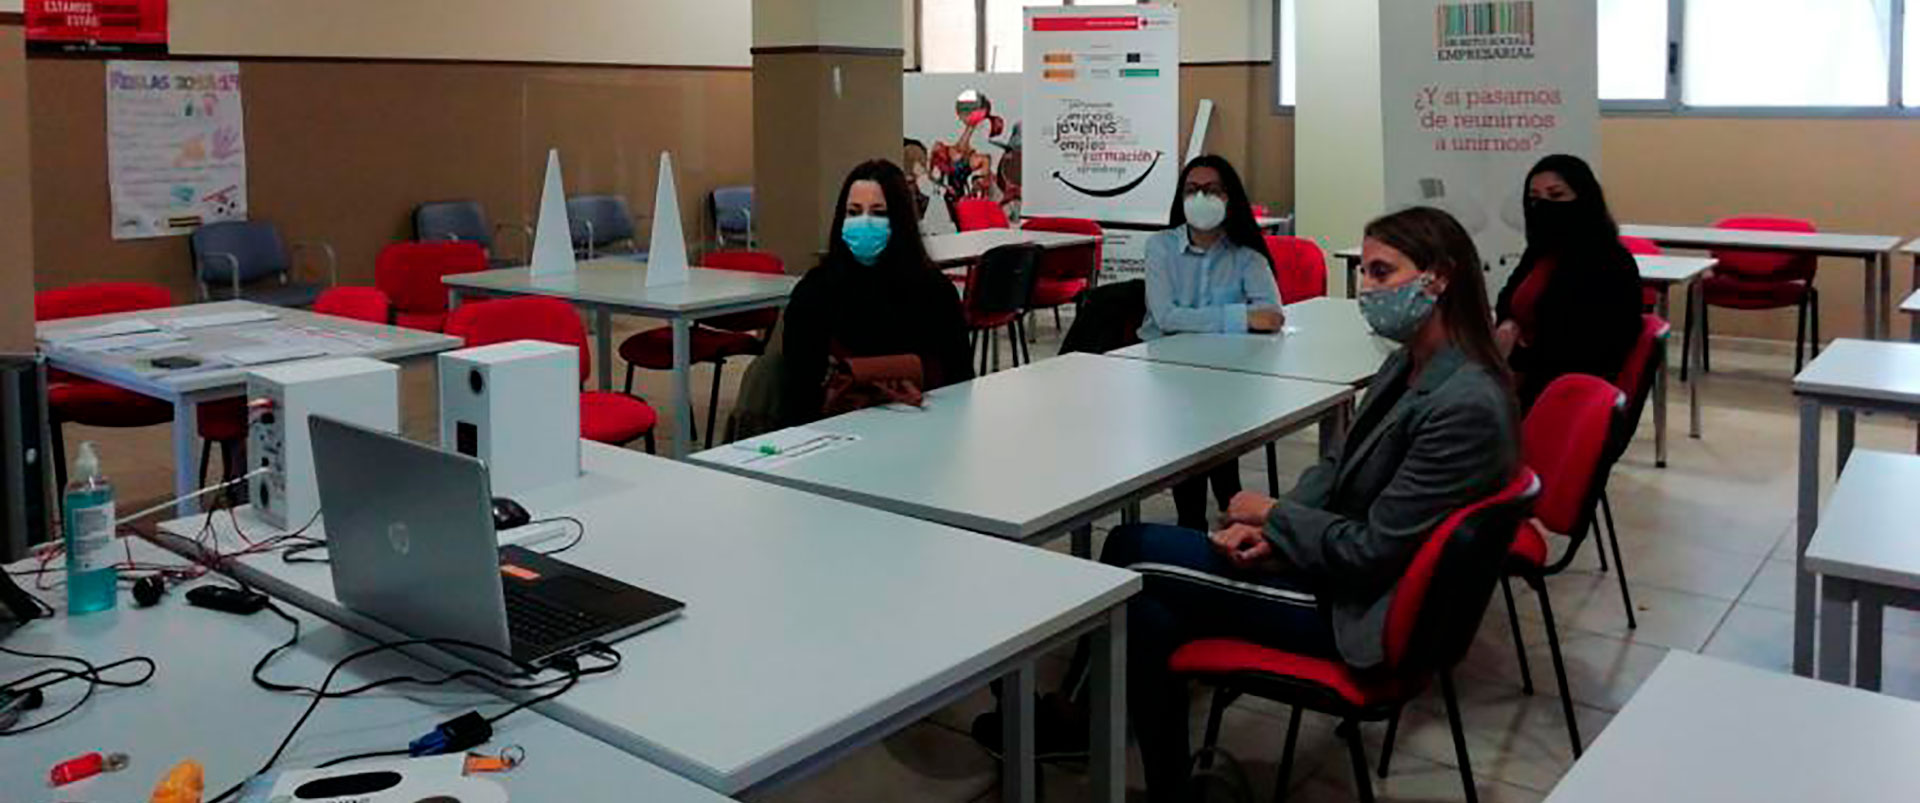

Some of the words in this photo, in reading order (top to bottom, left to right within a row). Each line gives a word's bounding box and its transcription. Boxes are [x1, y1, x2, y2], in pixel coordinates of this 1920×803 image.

[1437, 47, 1535, 61] EMPRESARIAL
[1414, 87, 1439, 110] ¿Y
[1443, 88, 1461, 105] si
[1466, 88, 1562, 109] pasamos
[1420, 112, 1448, 129] de
[1454, 112, 1556, 129] reunirnos
[1059, 137, 1107, 153] empleo
[1434, 139, 1446, 151] a
[1452, 133, 1544, 152] unirnos?
